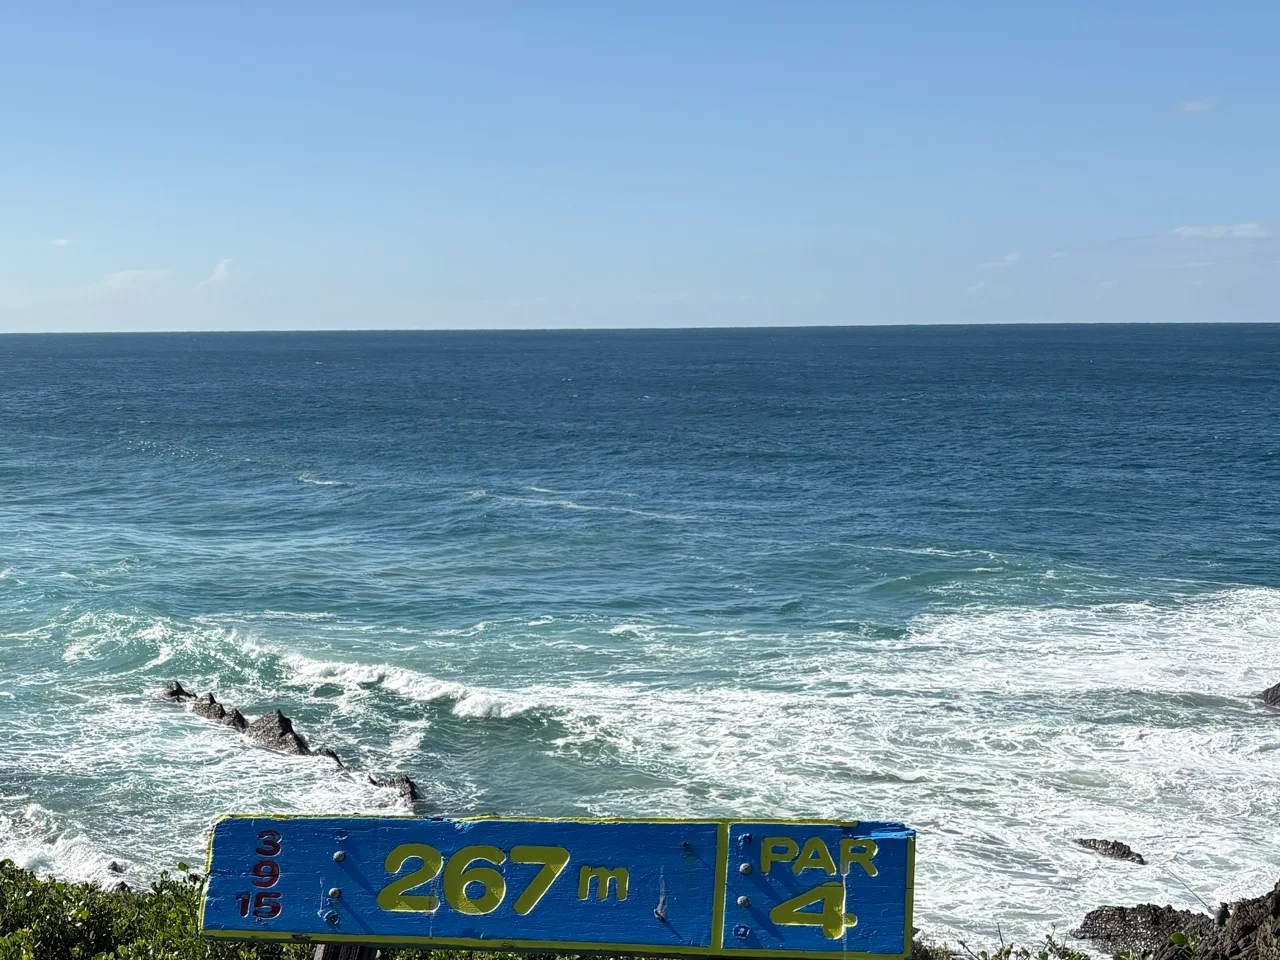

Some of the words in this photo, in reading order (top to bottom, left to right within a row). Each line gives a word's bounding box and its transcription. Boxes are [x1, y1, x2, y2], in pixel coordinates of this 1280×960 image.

[256, 829, 282, 857] 3
[760, 837, 879, 877] PAR
[252, 860, 281, 889] 9
[377, 843, 570, 915] 267
[577, 865, 629, 901] m
[236, 891, 282, 919] 15
[770, 881, 858, 940] 4
